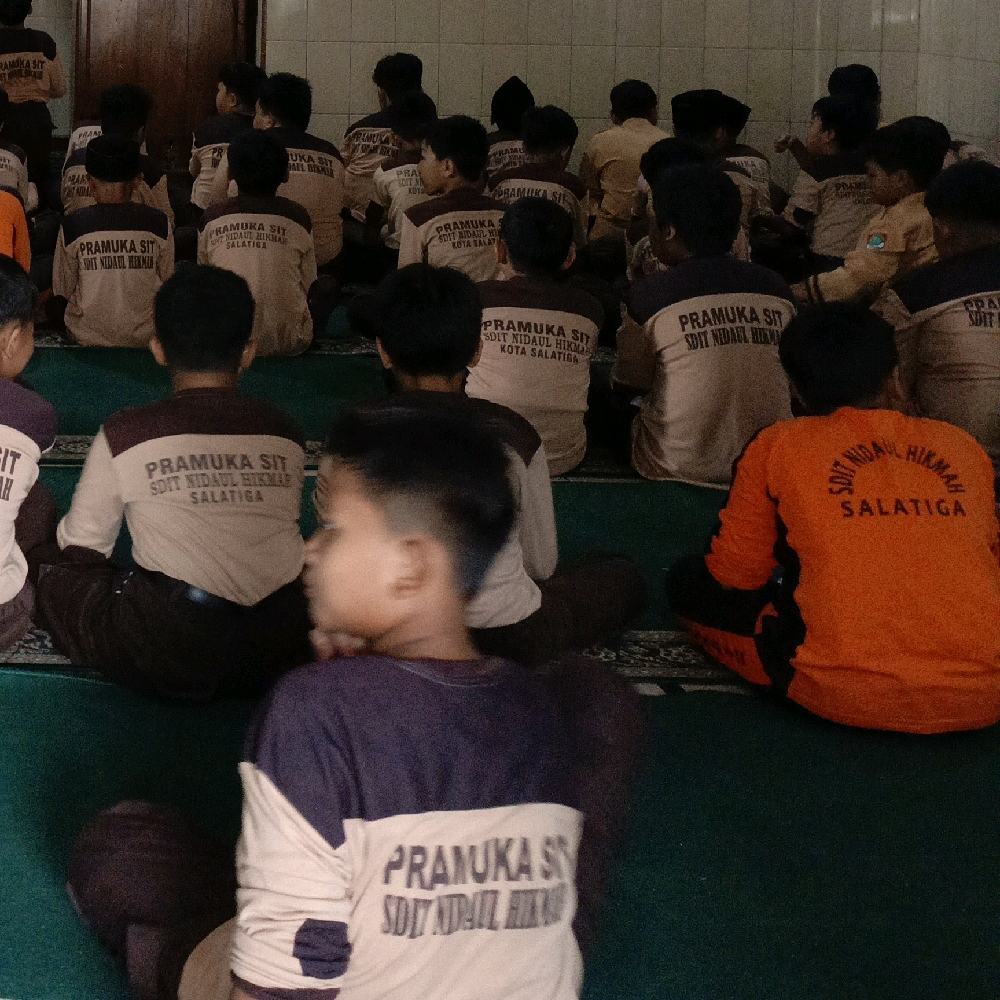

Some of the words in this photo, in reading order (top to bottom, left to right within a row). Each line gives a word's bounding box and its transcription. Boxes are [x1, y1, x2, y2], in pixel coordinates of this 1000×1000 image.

[210, 222, 265, 238] PRAMUKA
[269, 224, 287, 236] SIT
[436, 219, 495, 234] PRAMUKA
[79, 240, 138, 256] PRAMUKA
[140, 240, 155, 254] SIT
[679, 306, 761, 332] PRAMUKA
[763, 308, 783, 328] SIT
[482, 319, 566, 338] PRAMUKA
[571, 329, 591, 345] SIT
[482, 331, 509, 342] SDIT
[512, 332, 552, 348] NIDAUL
[685, 330, 710, 351] SDIT
[711, 326, 749, 347] NIDAUL
[500, 344, 527, 356] KOTA
[530, 348, 579, 363] SALATIGA
[145, 453, 254, 479] PRAMUKA
[259, 453, 288, 472] SIT
[842, 437, 902, 468] NIDAUL
[906, 444, 966, 494] HIKMAH
[149, 475, 181, 496] SDIT
[184, 473, 238, 488] NIDAUL
[190, 490, 264, 504] SALATIGA
[841, 499, 967, 519] SALATIGA
